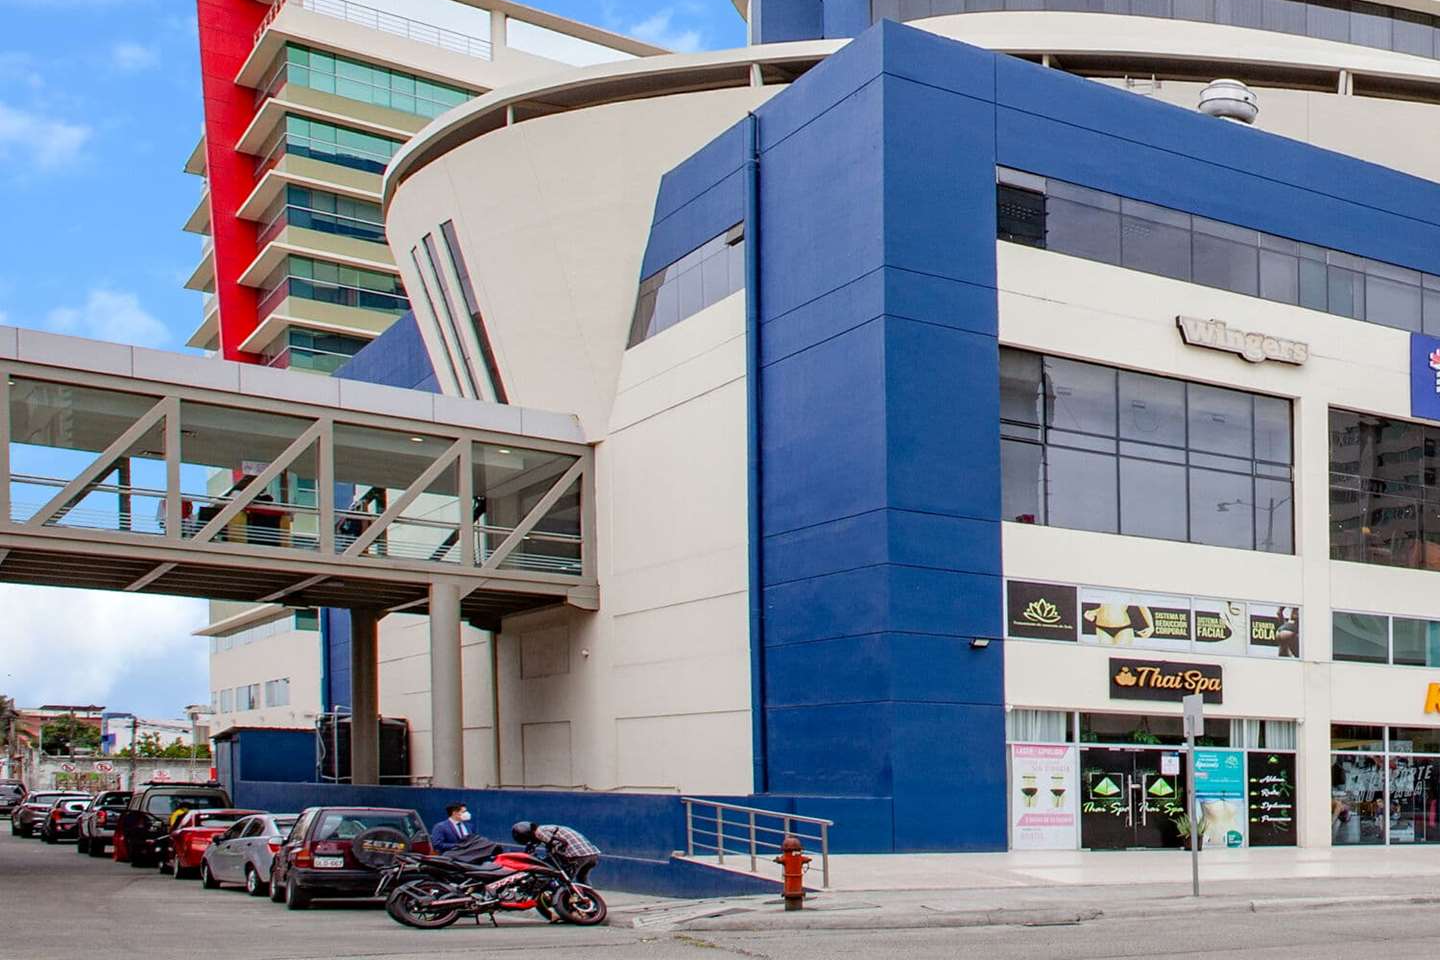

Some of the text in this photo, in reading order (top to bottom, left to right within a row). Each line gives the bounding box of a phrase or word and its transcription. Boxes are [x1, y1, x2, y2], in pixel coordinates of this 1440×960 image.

[1178, 316, 1310, 364] Wingers
[1154, 611, 1178, 620] SISTEMA
[1154, 627, 1187, 636] CORPORAL
[1196, 627, 1226, 639] FACIAL
[1251, 628, 1276, 640] COLA
[1136, 666, 1222, 696] Thai Spa
